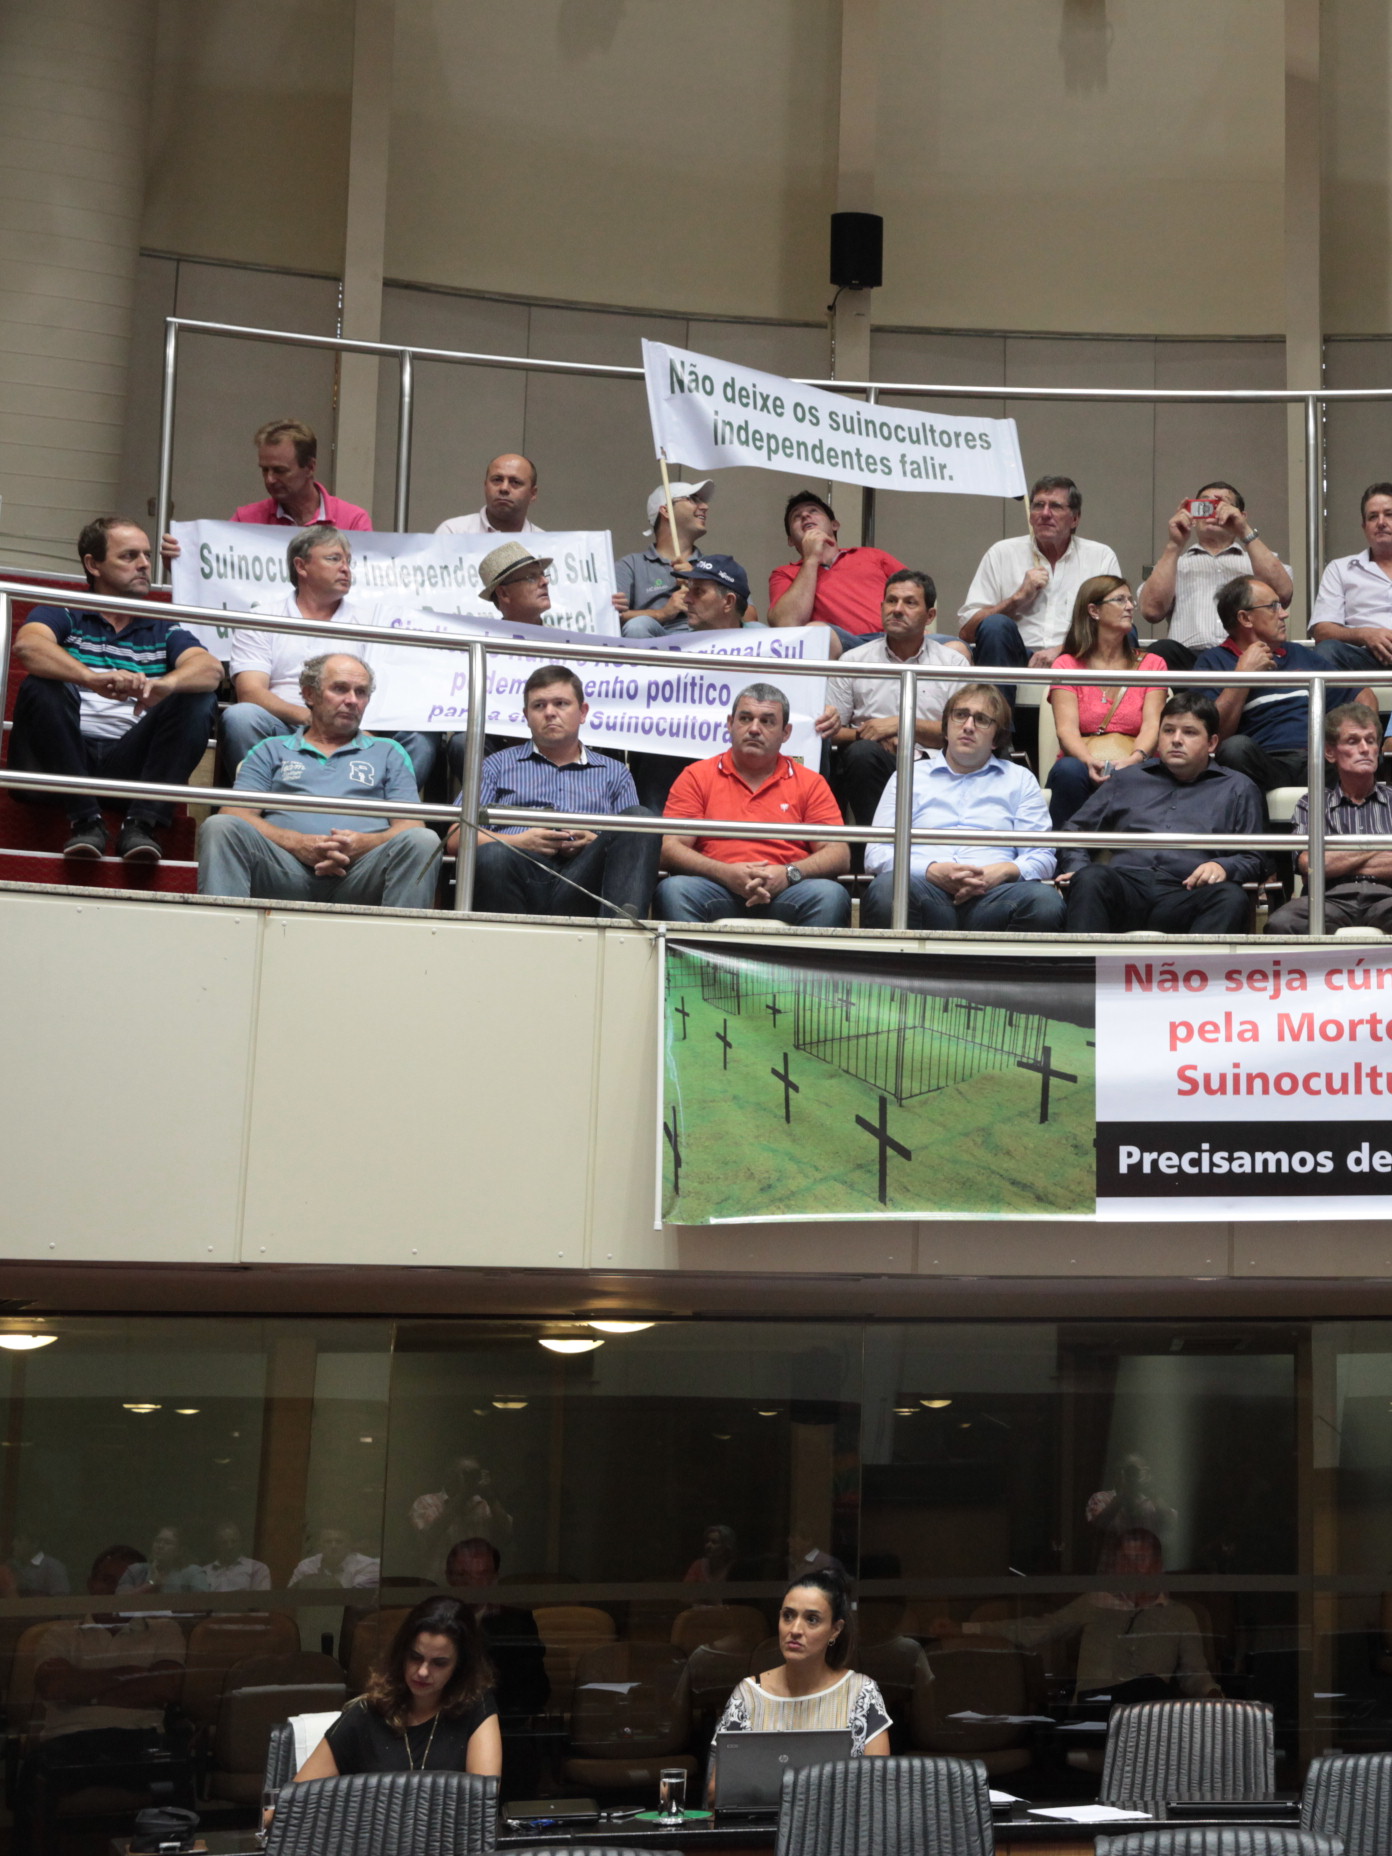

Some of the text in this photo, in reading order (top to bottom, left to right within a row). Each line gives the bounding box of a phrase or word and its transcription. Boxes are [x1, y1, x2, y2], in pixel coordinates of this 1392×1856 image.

[669, 357, 992, 450] Não deixe os suinocultores
[713, 410, 955, 481] independentes falir.
[363, 555, 479, 595] Independe
[565, 552, 598, 583] Sul
[450, 670, 527, 697] pdem
[646, 672, 731, 709] político
[1124, 961, 1209, 993] Não
[1225, 960, 1308, 1000] seja
[1169, 1011, 1261, 1051] pela
[1118, 1143, 1335, 1175] Precisamos
